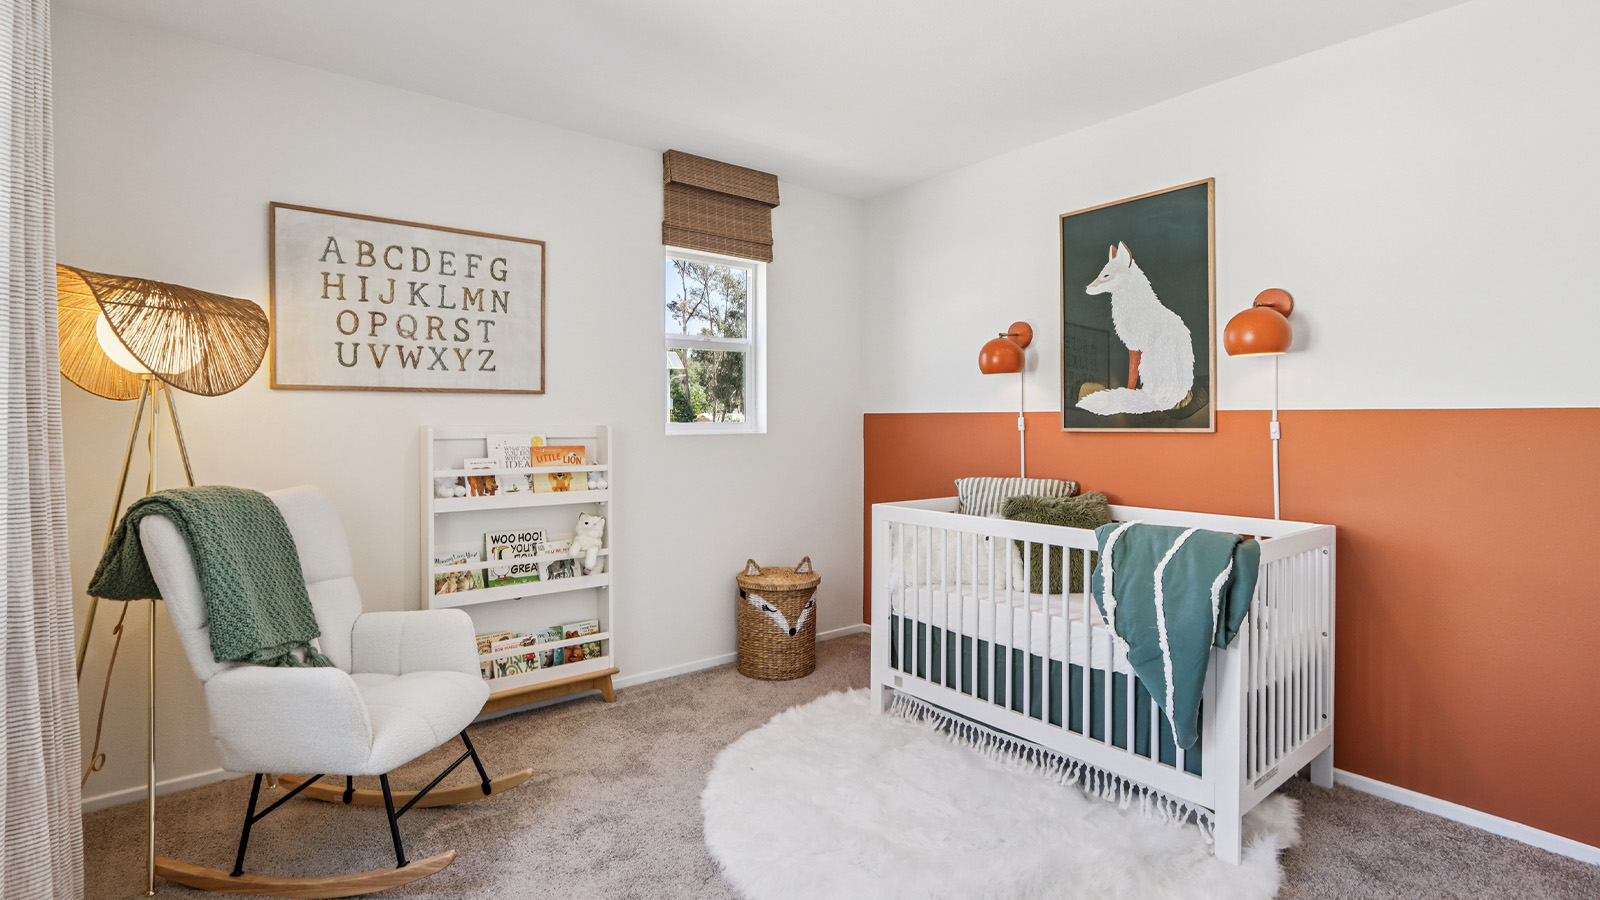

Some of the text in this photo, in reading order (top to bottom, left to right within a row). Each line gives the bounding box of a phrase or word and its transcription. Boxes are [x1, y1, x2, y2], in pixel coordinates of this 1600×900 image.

[536, 453, 582, 464] LITTLE LION
[491, 531, 543, 544] WOO HOO!
[511, 563, 538, 574] GREA
